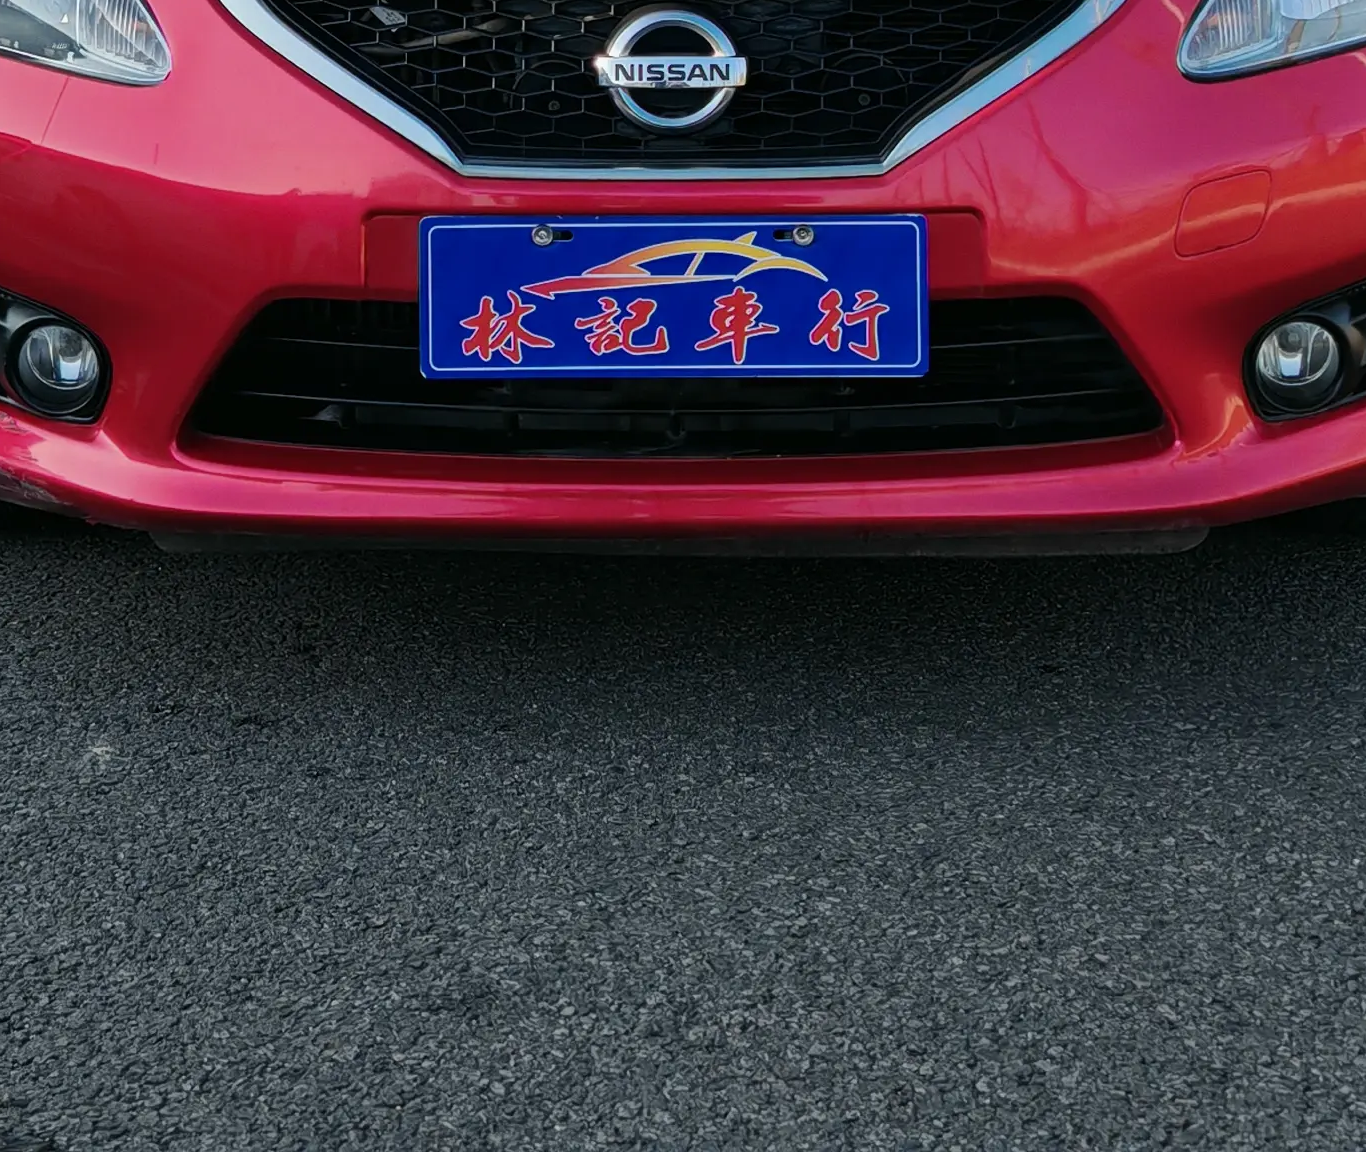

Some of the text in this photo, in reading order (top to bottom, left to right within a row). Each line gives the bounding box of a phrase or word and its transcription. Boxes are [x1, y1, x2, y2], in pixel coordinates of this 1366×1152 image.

[615, 63, 730, 82] NISSAN
[459, 285, 890, 365] 林記車行
